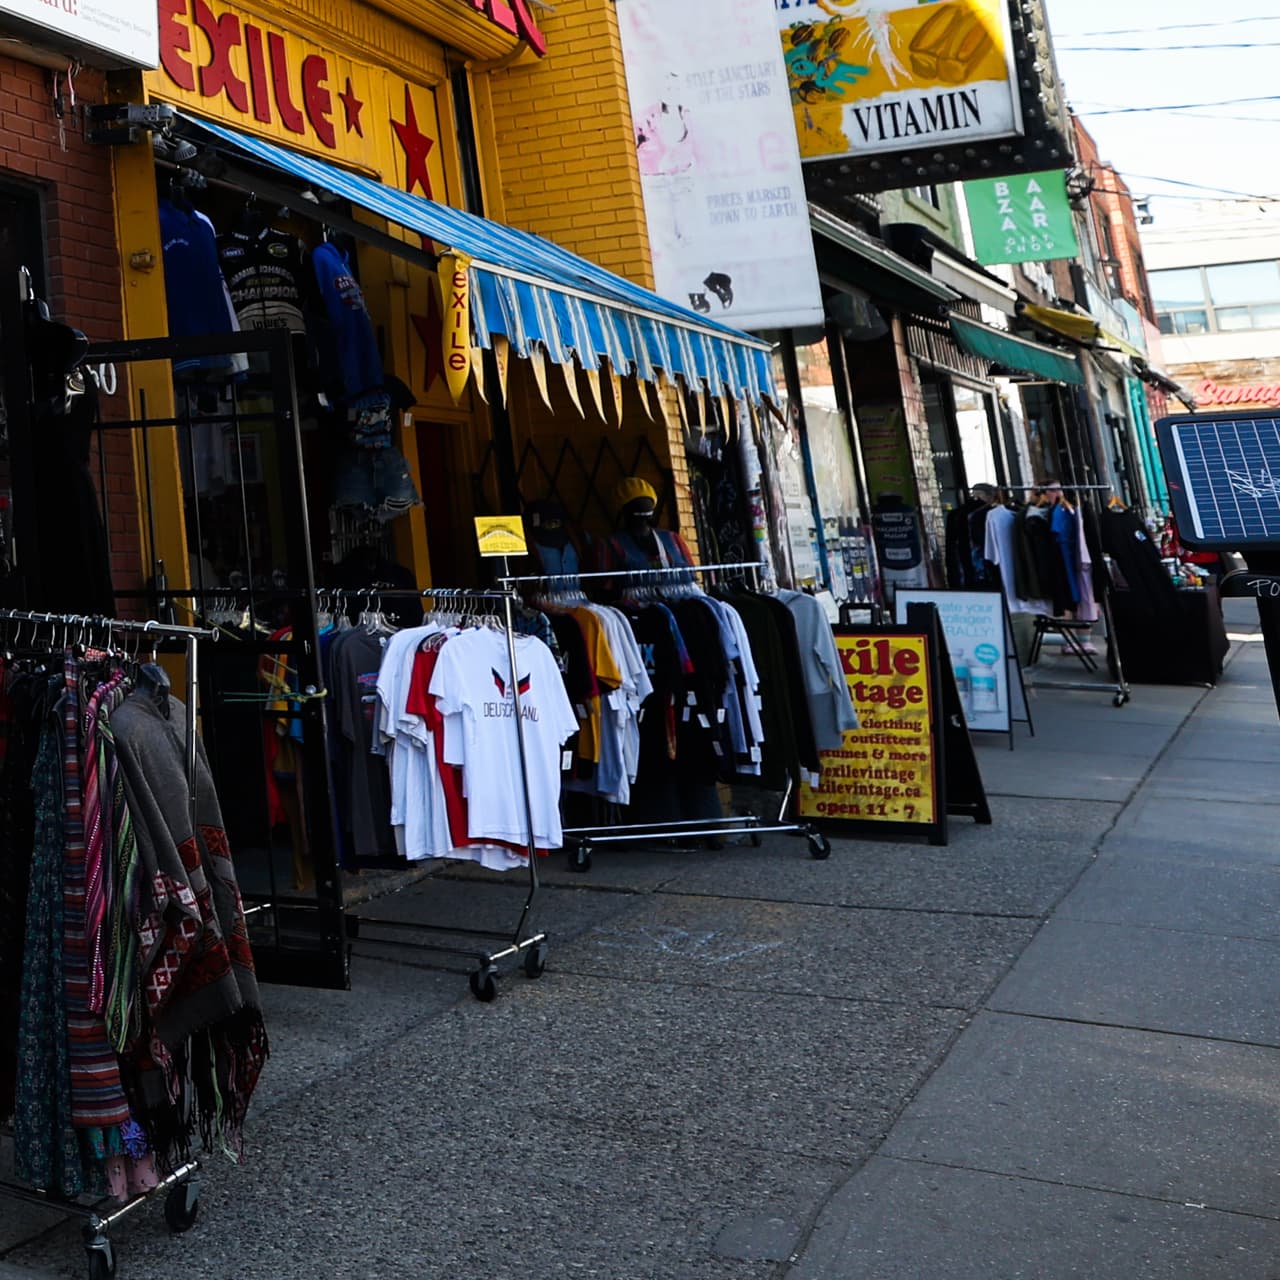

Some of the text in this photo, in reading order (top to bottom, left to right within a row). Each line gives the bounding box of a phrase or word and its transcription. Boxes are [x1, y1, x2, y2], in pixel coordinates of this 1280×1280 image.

[852, 89, 983, 143] VITAMIN
[837, 639, 920, 676] xile
[848, 681, 924, 709] tage
[861, 718, 922, 733] clothing
[850, 733, 921, 746] outfitters
[872, 748, 885, 760] &
[889, 749, 927, 761] more
[816, 800, 861, 815] open
[867, 802, 887, 816] 11
[903, 805, 916, 819] 7
